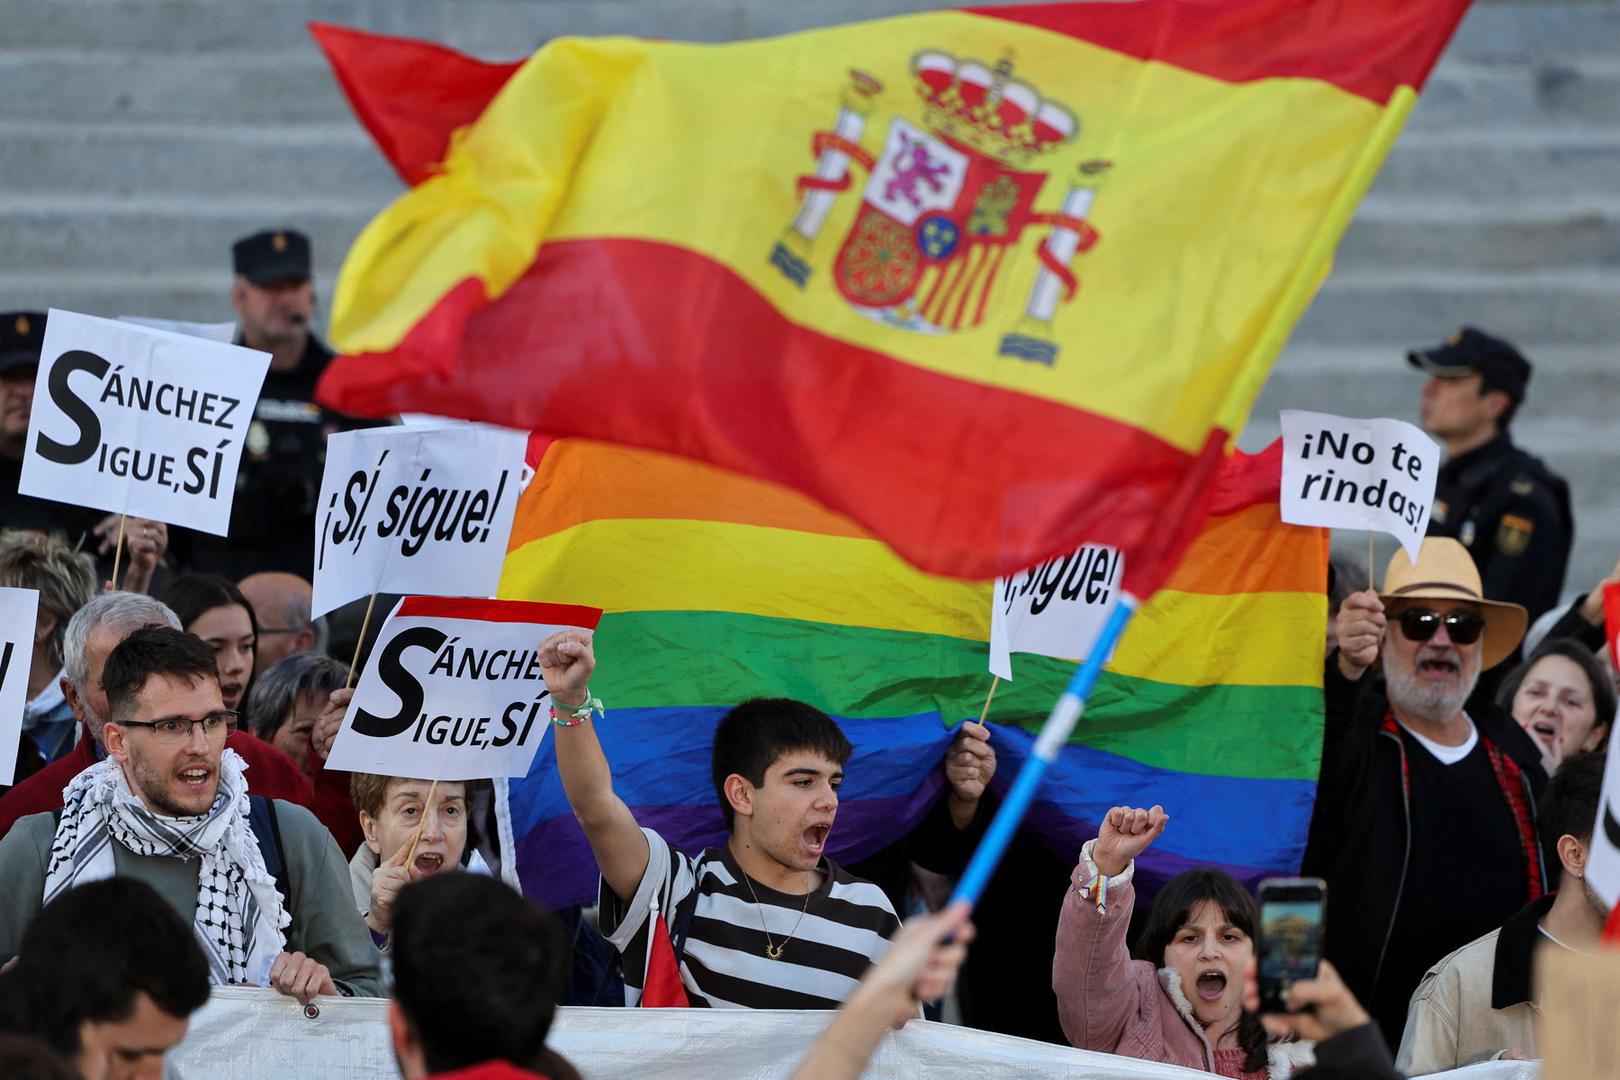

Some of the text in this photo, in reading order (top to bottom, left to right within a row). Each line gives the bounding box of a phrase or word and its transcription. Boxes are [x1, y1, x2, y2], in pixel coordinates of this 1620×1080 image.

[1301, 430, 1422, 481] ¡No te
[377, 469, 509, 557] sigue!
[1301, 469, 1424, 533] rindas!
[351, 627, 546, 738] SÁNCHE
